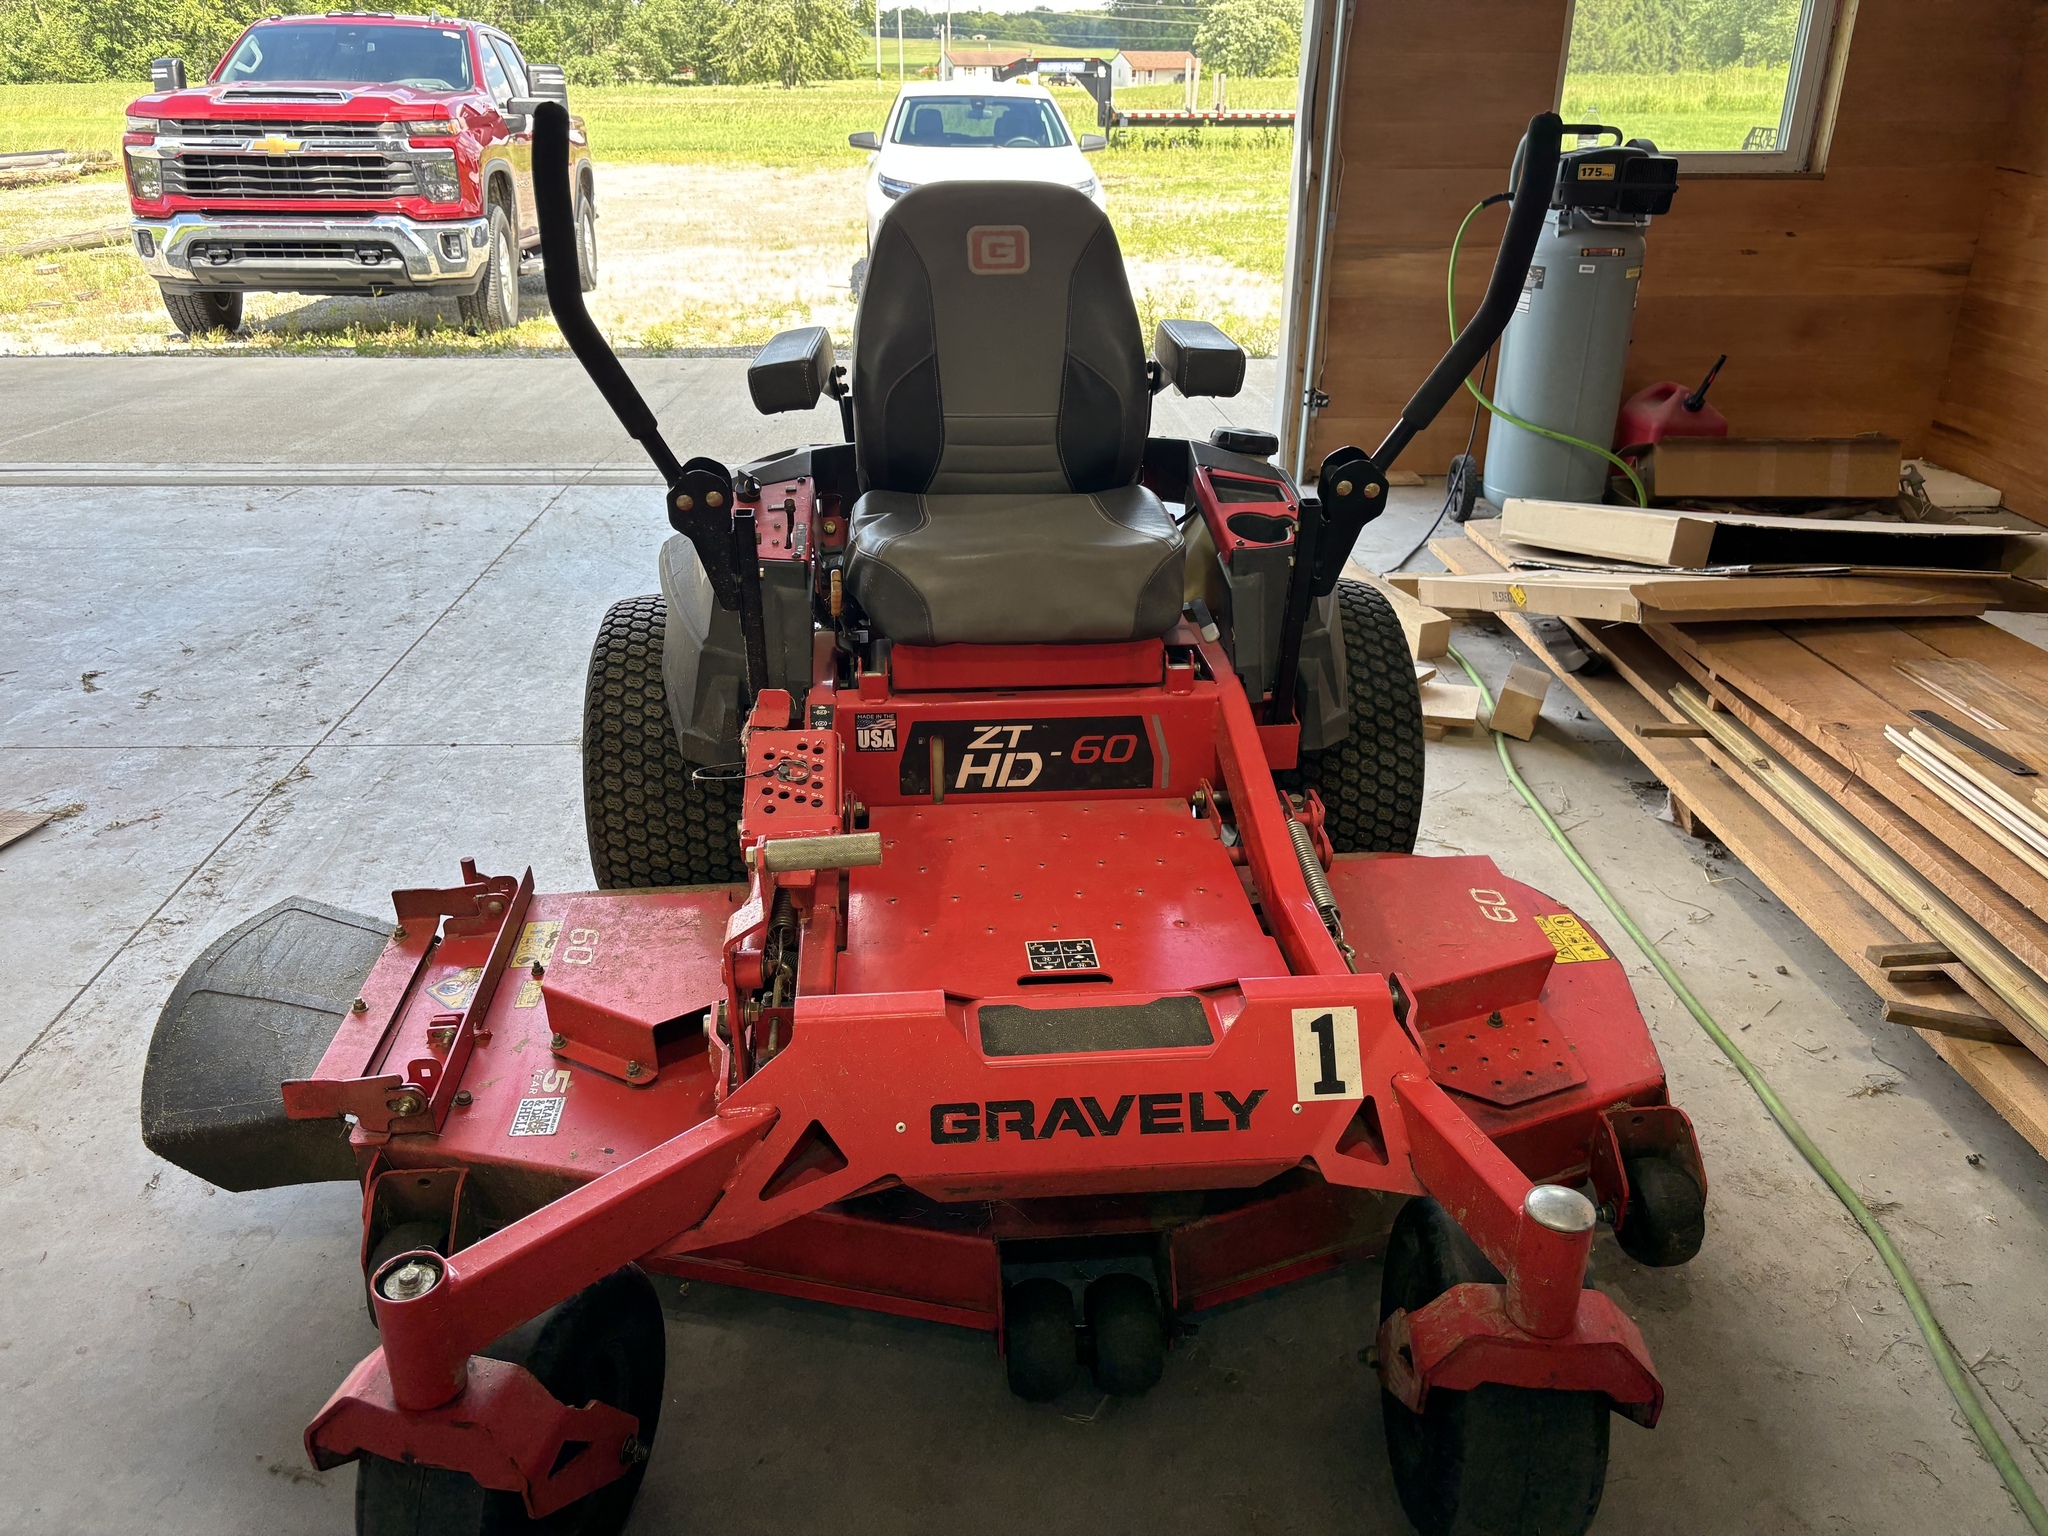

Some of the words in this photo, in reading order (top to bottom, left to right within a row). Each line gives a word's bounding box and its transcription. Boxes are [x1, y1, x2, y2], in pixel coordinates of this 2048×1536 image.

[1581, 167, 1602, 177] 175
[857, 729, 895, 748] USA
[967, 725, 1033, 749] ZT
[1468, 888, 1519, 923] 60
[562, 928, 600, 965] 60
[1310, 1013, 1346, 1095] 1
[528, 1068, 546, 1095] YEAR
[542, 1068, 572, 1094] 5
[511, 1100, 534, 1135] SHELL
[536, 1099, 557, 1134] FRAME
[930, 1089, 1269, 1145] GRAVELY
